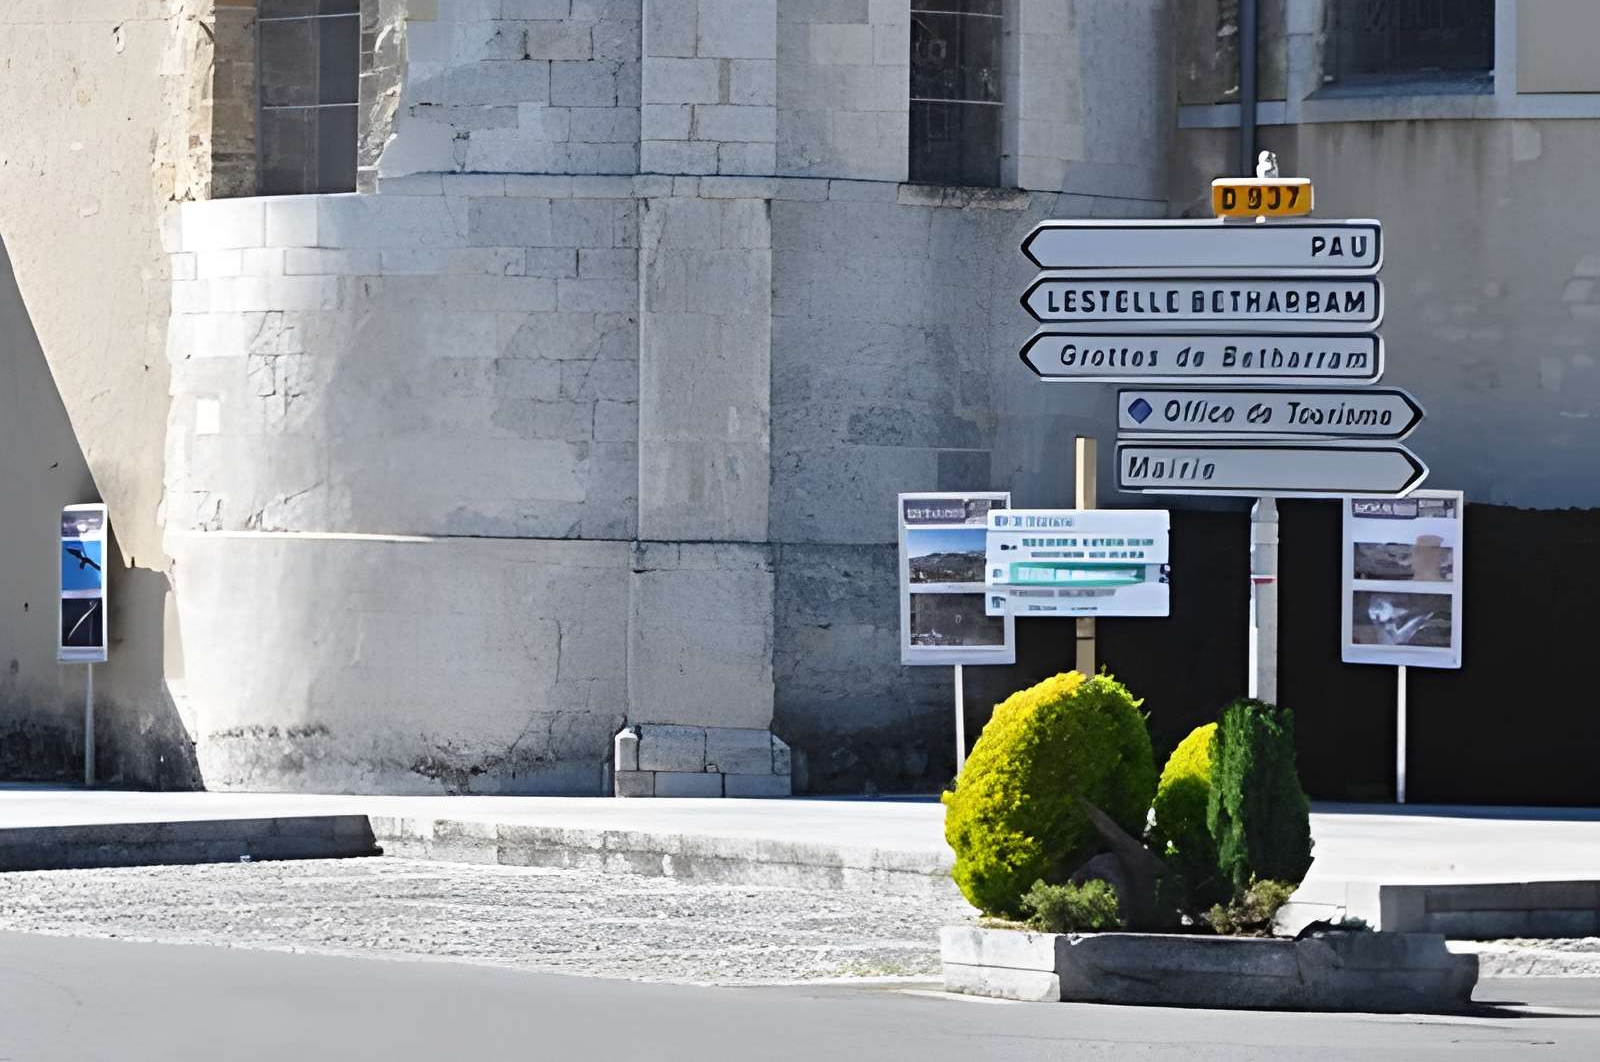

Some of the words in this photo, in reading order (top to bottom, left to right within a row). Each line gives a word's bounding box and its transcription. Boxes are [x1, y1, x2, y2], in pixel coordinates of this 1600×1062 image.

[1222, 187, 1236, 210] D
[1311, 235, 1368, 257] PAU
[1048, 290, 1180, 313] LESTELLE
[1192, 290, 1366, 314] BETHARRAM
[1060, 344, 1159, 368] Grottes
[1176, 345, 1205, 368] de
[1164, 399, 1235, 423] Office
[1288, 401, 1392, 426] Tourisme
[1128, 456, 1215, 481] Mairie
